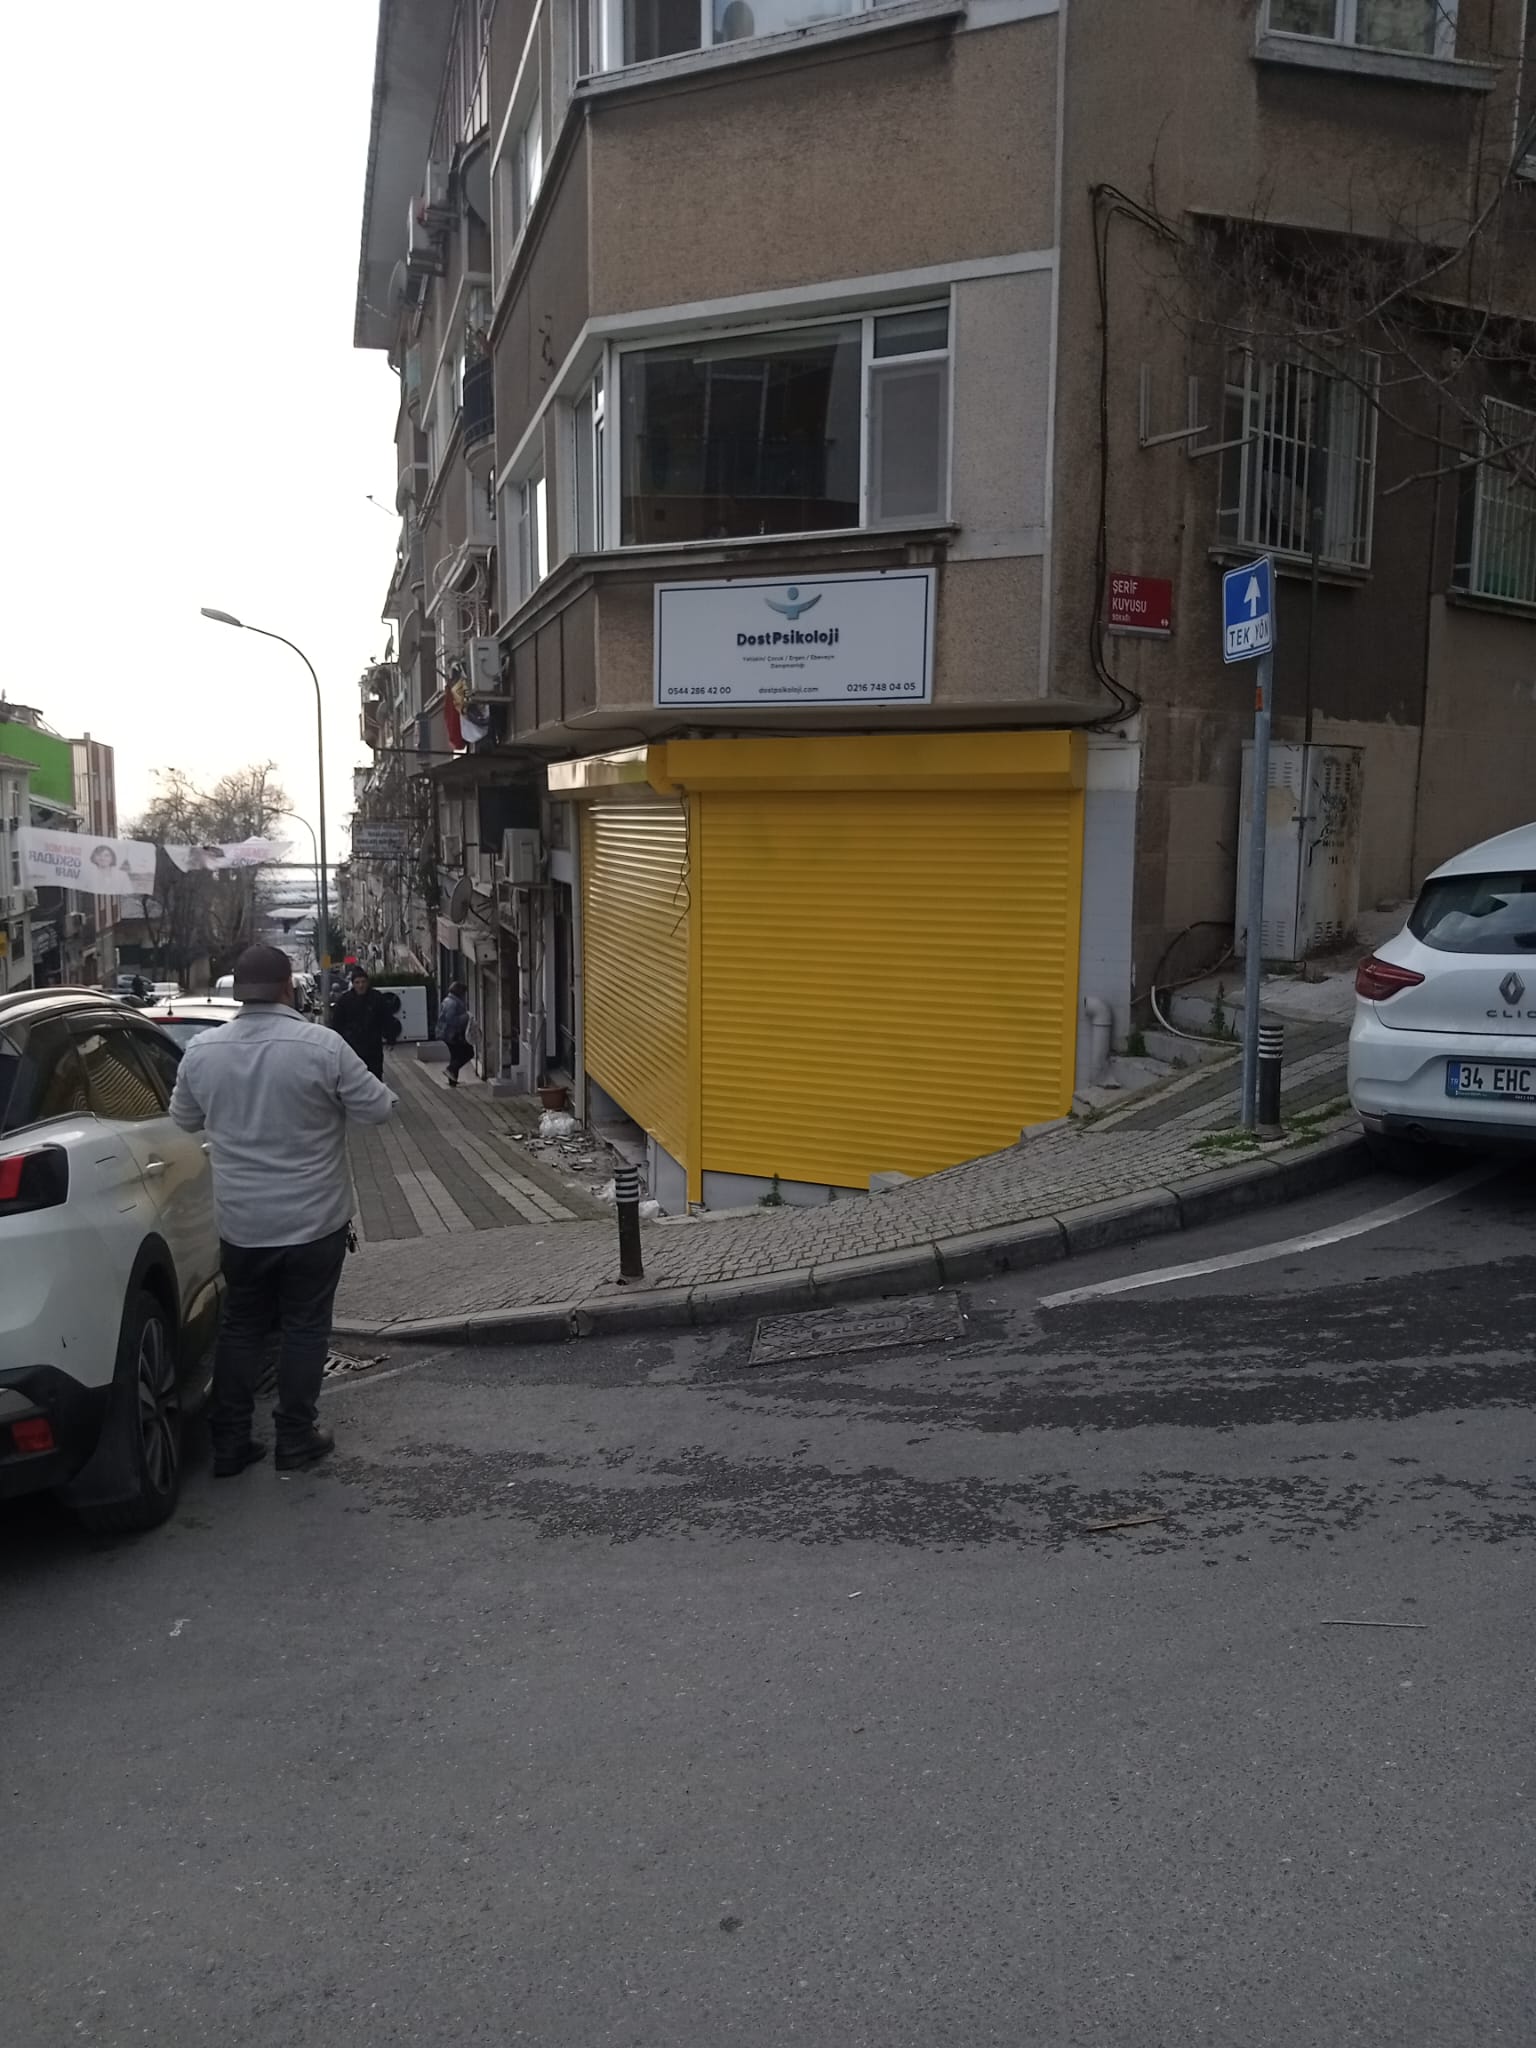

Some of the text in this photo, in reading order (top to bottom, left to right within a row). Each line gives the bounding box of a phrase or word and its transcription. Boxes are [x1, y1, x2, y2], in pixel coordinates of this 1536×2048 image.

[1112, 579, 1138, 594] ŞERİF
[1112, 597, 1147, 613] KUYUSU
[736, 628, 840, 647] DostPsikoloji
[1229, 618, 1268, 648] TEK YÖN
[667, 687, 688, 695] 0544
[707, 686, 717, 695] 42
[719, 686, 732, 695] 00
[847, 681, 916, 692] 0216 748 04 05
[1461, 1067, 1532, 1092] 34 EHC
